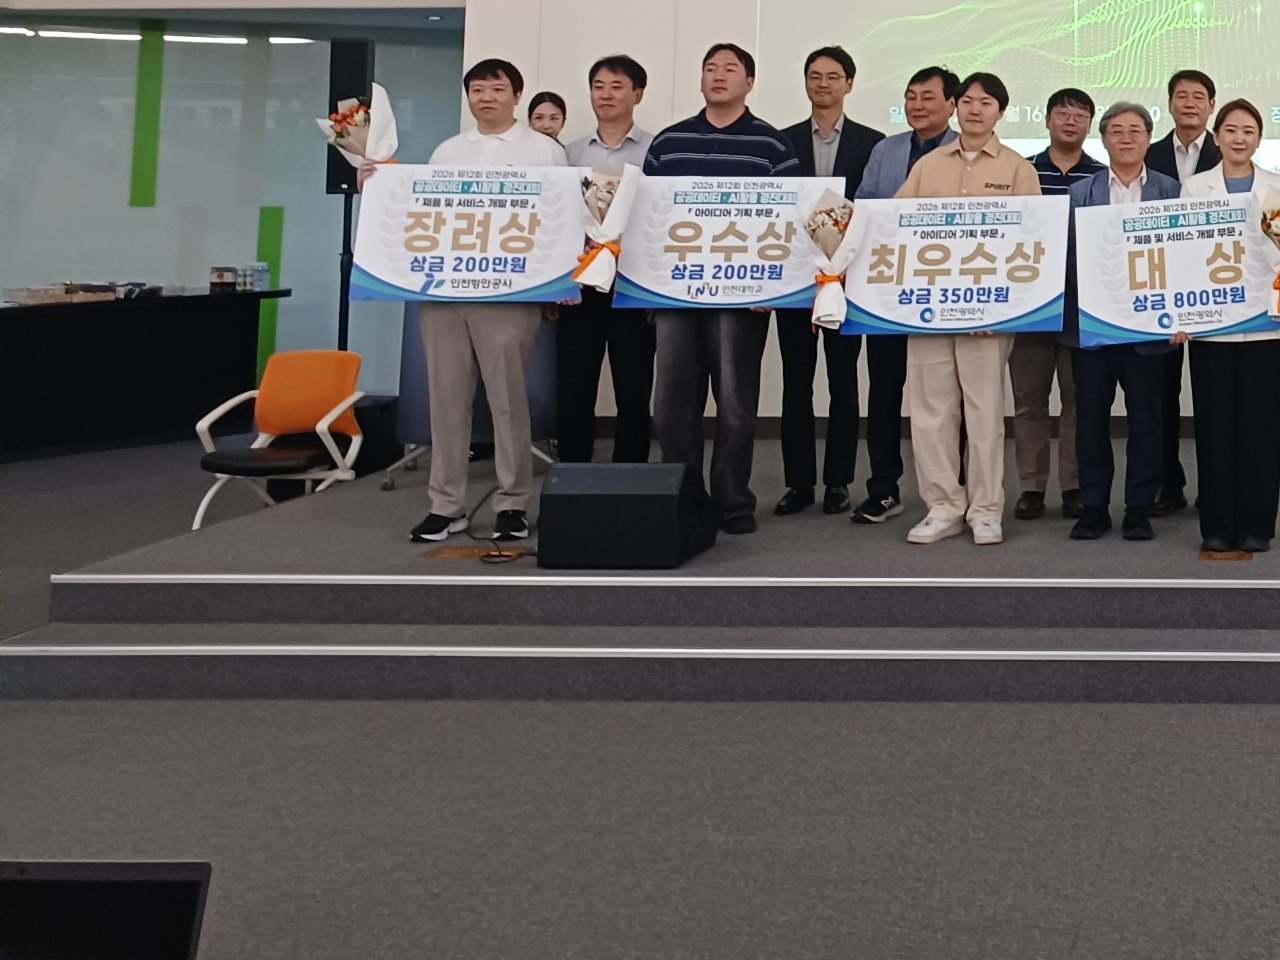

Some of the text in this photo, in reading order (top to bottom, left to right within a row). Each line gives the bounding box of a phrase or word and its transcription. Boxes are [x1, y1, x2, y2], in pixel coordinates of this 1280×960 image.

[431, 170, 455, 178] 2026
[485, 171, 527, 179] 인천광역시
[414, 181, 541, 195] 공공데이터 AI활용 경진대회
[692, 182, 714, 190] 2026
[743, 182, 783, 190] 인천광역시
[983, 182, 1011, 191] SPIRIT
[444, 198, 454, 208] 및
[456, 198, 485, 208] 서비스
[488, 198, 508, 208] 개발
[675, 192, 796, 204] 공공데이터 AI활용 경진대회
[734, 208, 752, 218] 기획
[917, 202, 939, 211] 2026
[967, 201, 1007, 210] 인천광역시
[1139, 206, 1161, 215] 2026
[1190, 199, 1229, 210] 인천광역시
[900, 211, 1021, 226] 공공데이터 AI활용 경진대회
[1124, 209, 1245, 231] 공공데이터 AI활용 경진대회
[404, 211, 541, 254] 장려상
[959, 230, 977, 240] 기획
[1154, 233, 1164, 243] 및
[1166, 231, 1194, 242] 서비스
[1196, 228, 1215, 239] 개발
[664, 221, 797, 262] 우수상
[409, 256, 527, 273] 상금 200만원
[867, 241, 1045, 286] 최우수상
[671, 264, 784, 280] 상금 200만원
[450, 278, 512, 290] 인천항만공사
[898, 286, 1010, 305] 상금 350만원
[1132, 286, 1246, 312] 상금 800만원
[940, 307, 985, 317] 인천광역시
[1178, 309, 1222, 321] 인천광역시
